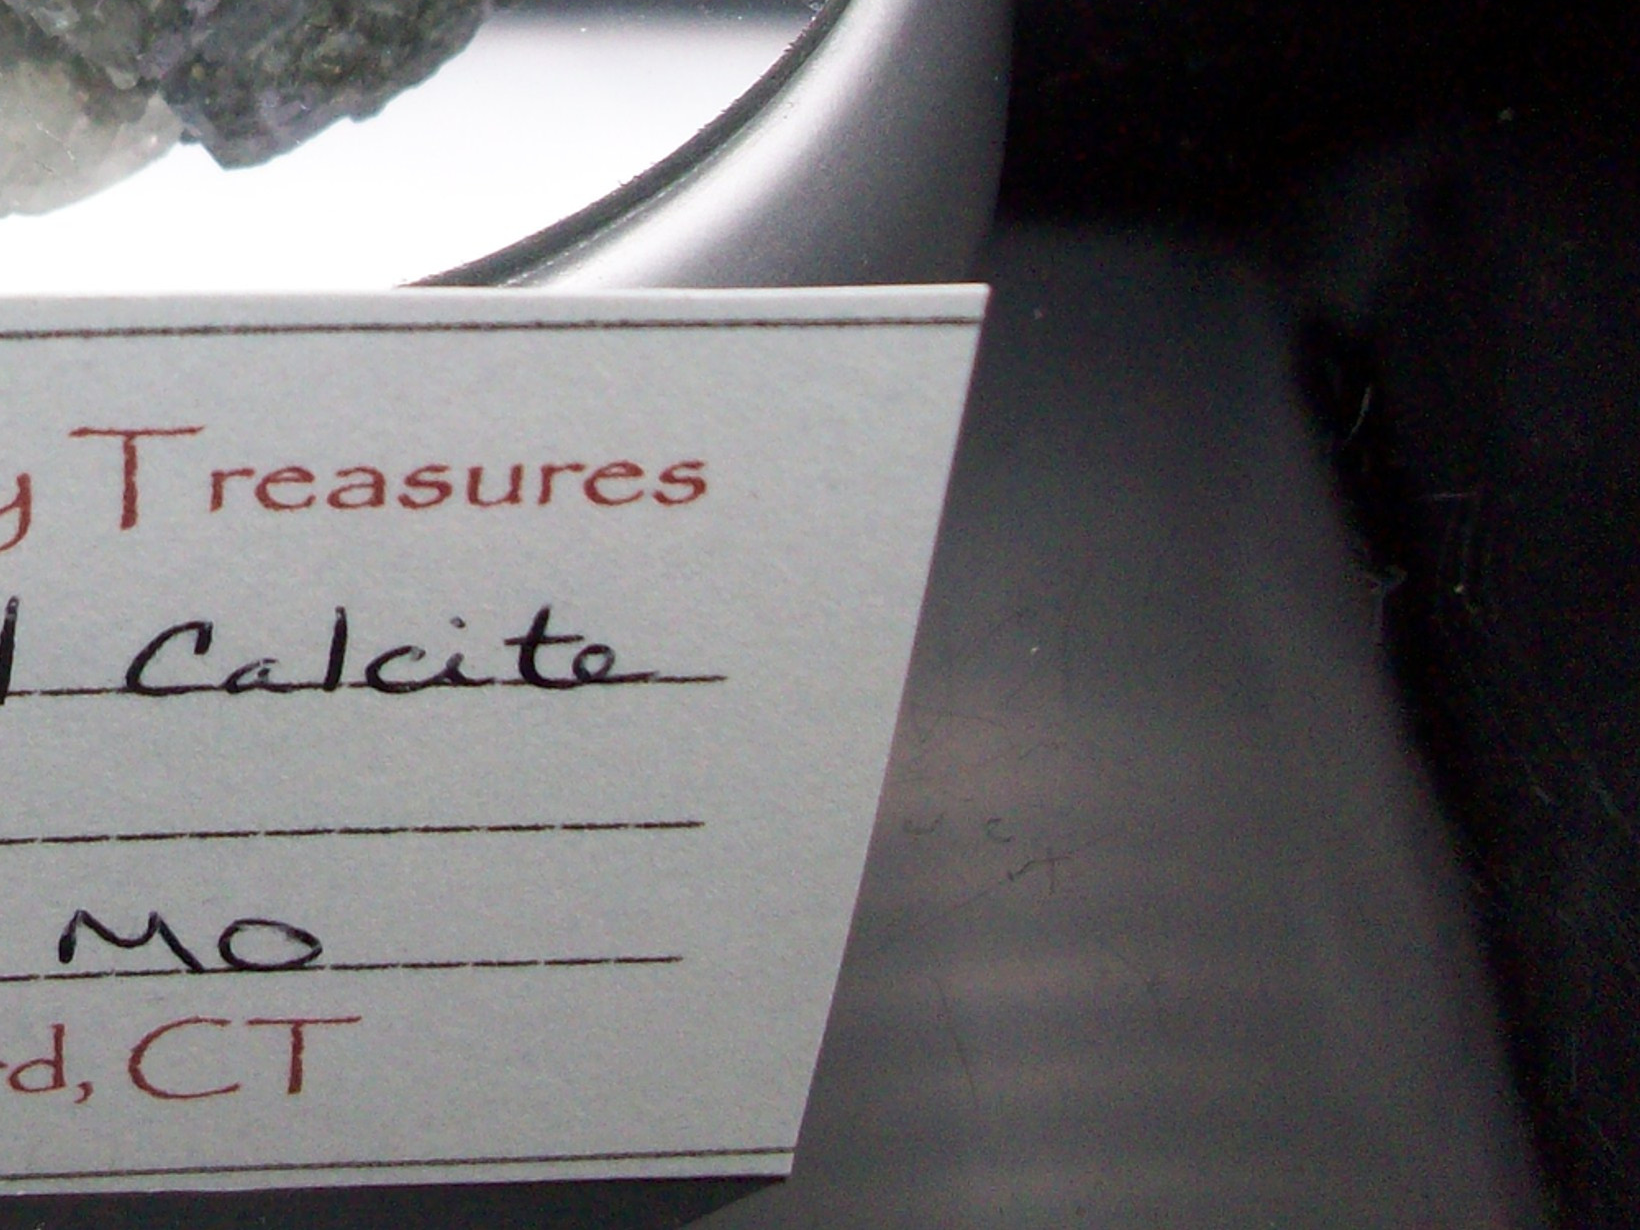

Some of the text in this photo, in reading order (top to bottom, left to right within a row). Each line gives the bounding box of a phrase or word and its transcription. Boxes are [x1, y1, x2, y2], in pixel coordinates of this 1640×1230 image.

[67, 426, 707, 532] Treasures
[124, 604, 654, 697] Calcite
[58, 908, 324, 973] MO
[126, 1015, 363, 1101] CT
